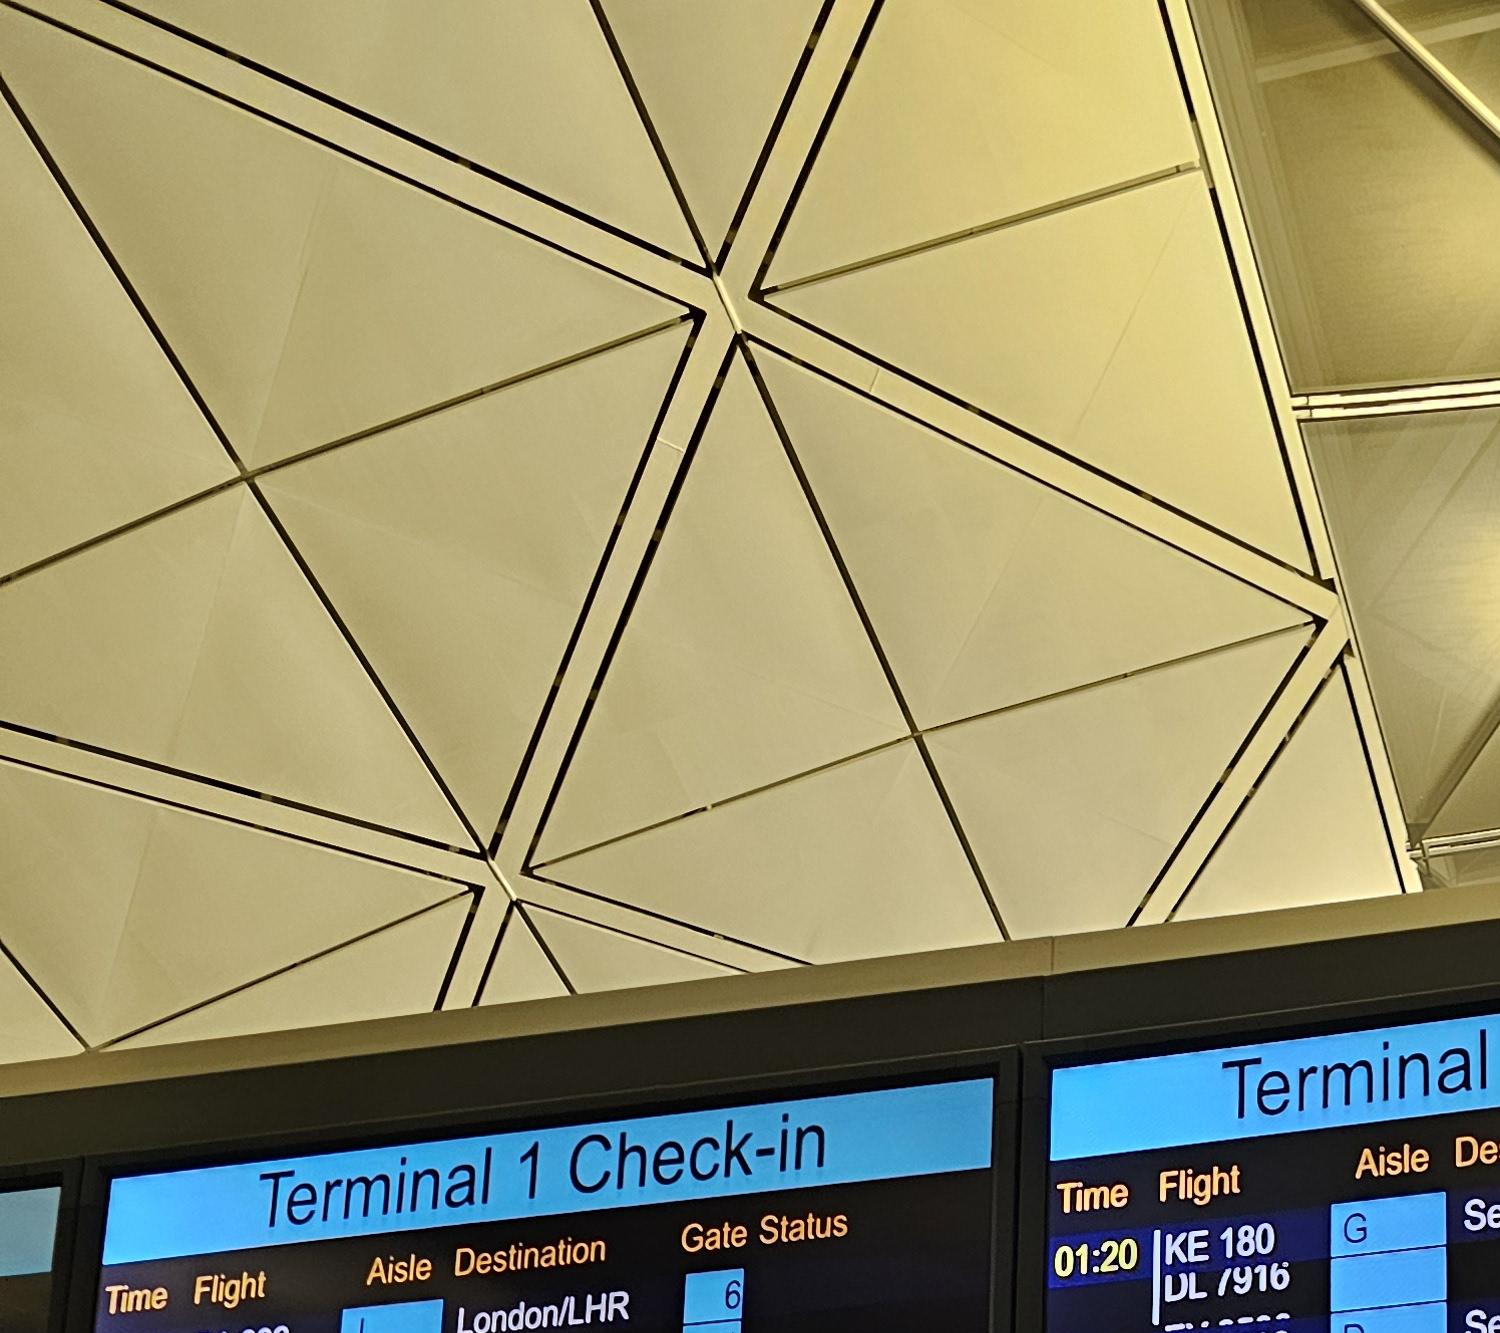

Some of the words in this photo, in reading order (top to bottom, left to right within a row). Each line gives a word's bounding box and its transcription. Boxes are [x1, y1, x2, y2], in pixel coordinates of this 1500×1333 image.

[1221, 1028, 1487, 1120] Terminal
[259, 1146, 493, 1228] Terminal
[519, 1140, 540, 1200] 1
[569, 1112, 825, 1194] Check-in
[1056, 1181, 1129, 1214] Time
[1159, 1164, 1241, 1206] Flight
[1355, 1143, 1430, 1180] Aisle
[104, 1284, 168, 1315] Time
[193, 1270, 267, 1309] Flight
[366, 1253, 432, 1286] Aisle
[454, 1239, 606, 1277] Destination
[681, 1221, 748, 1253] Gate
[759, 1212, 848, 1245] Status
[1054, 1238, 1138, 1278] 01:20
[1164, 1229, 1210, 1266] KE
[1219, 1222, 1275, 1259] 180
[1343, 1212, 1368, 1244] G
[725, 1279, 741, 1310] 6
